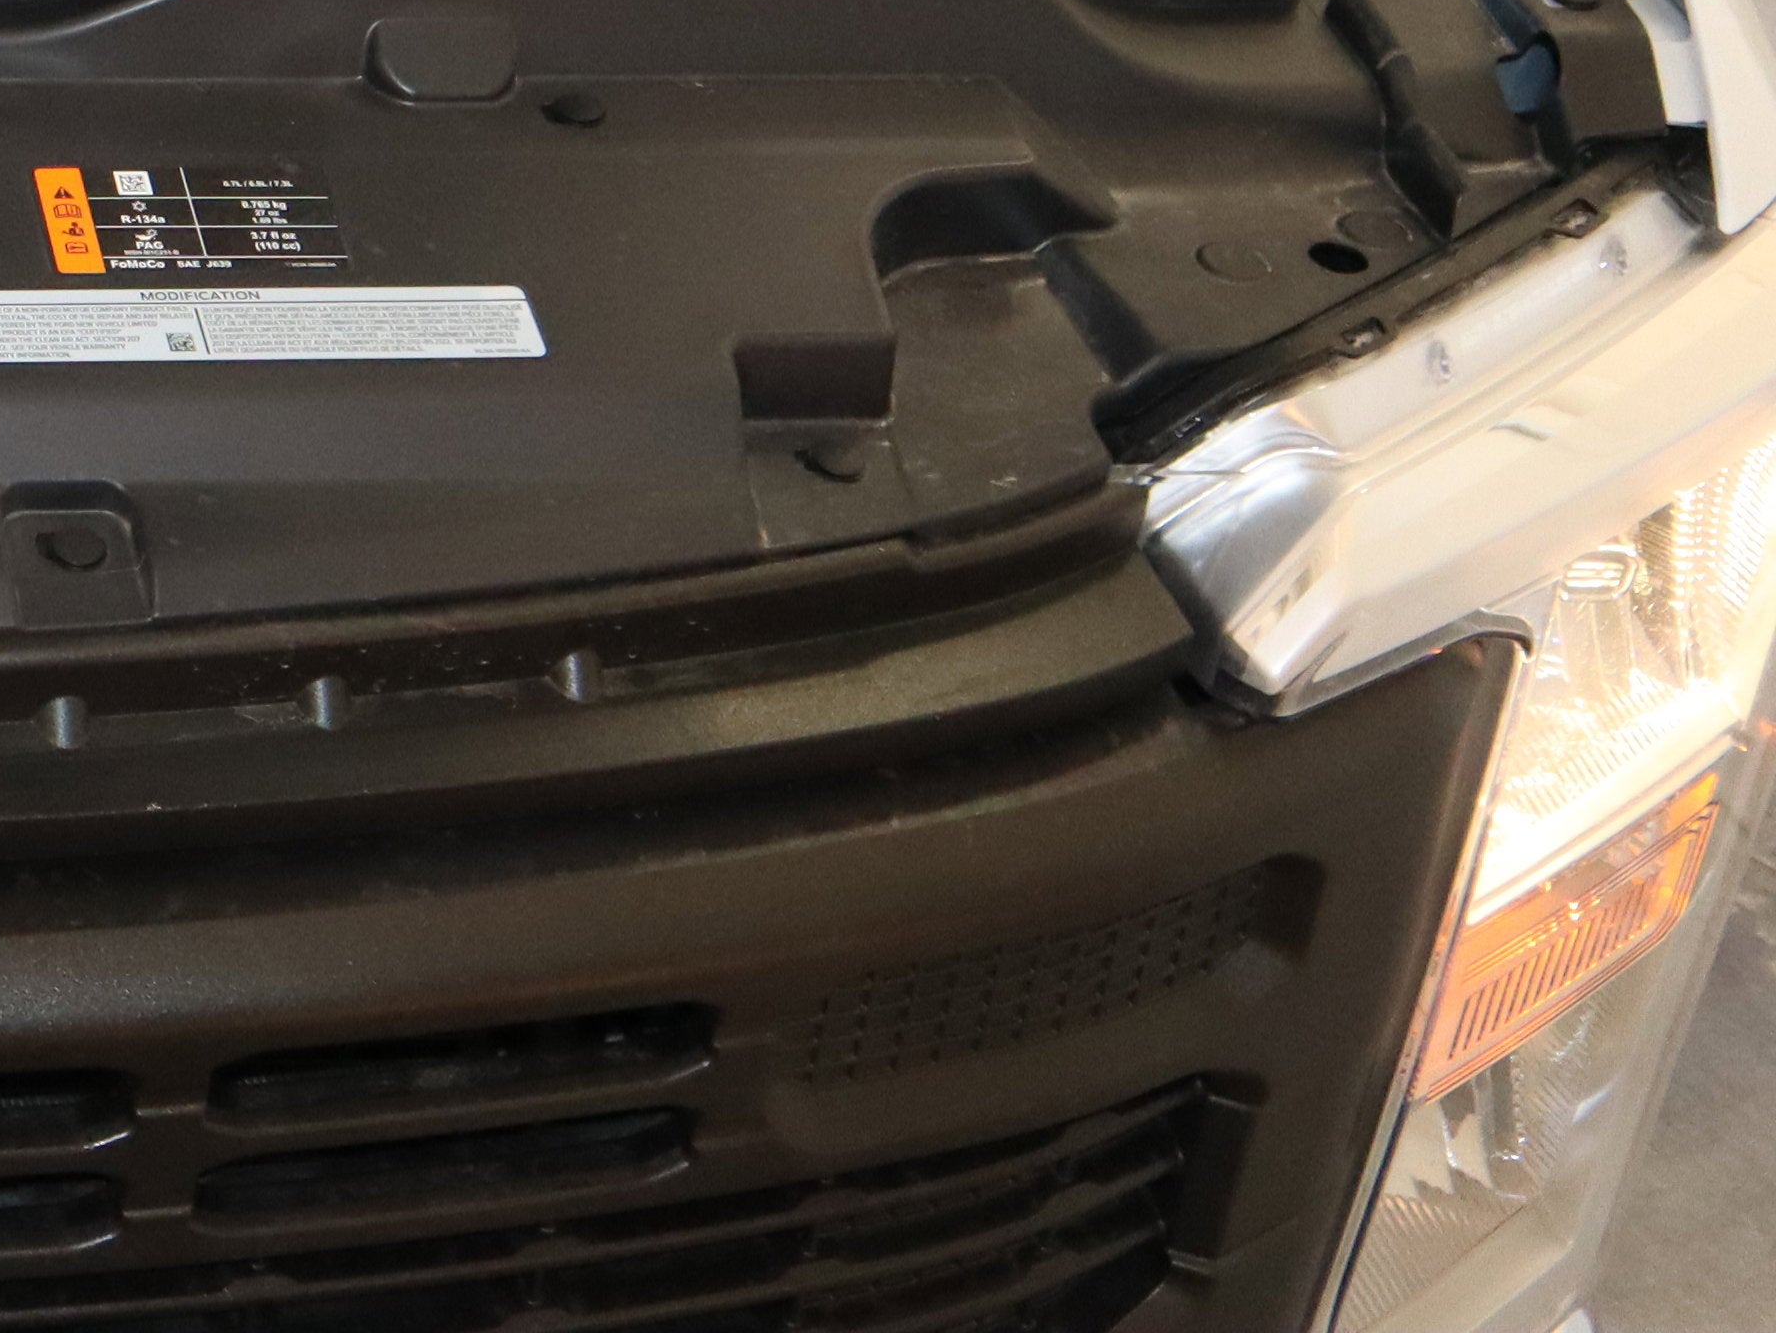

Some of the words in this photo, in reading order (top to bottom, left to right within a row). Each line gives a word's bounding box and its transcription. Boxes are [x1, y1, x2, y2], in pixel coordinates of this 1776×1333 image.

[271, 200, 287, 211] kg
[120, 214, 166, 224] R-134a
[250, 231, 267, 240] 3.7
[282, 232, 297, 240] oz
[135, 241, 164, 250] PAG
[255, 241, 280, 252] (110
[282, 241, 301, 252] cc)
[110, 260, 166, 269] FoMoCo
[177, 260, 201, 269] SAE
[140, 291, 260, 301] MODIFICATION
